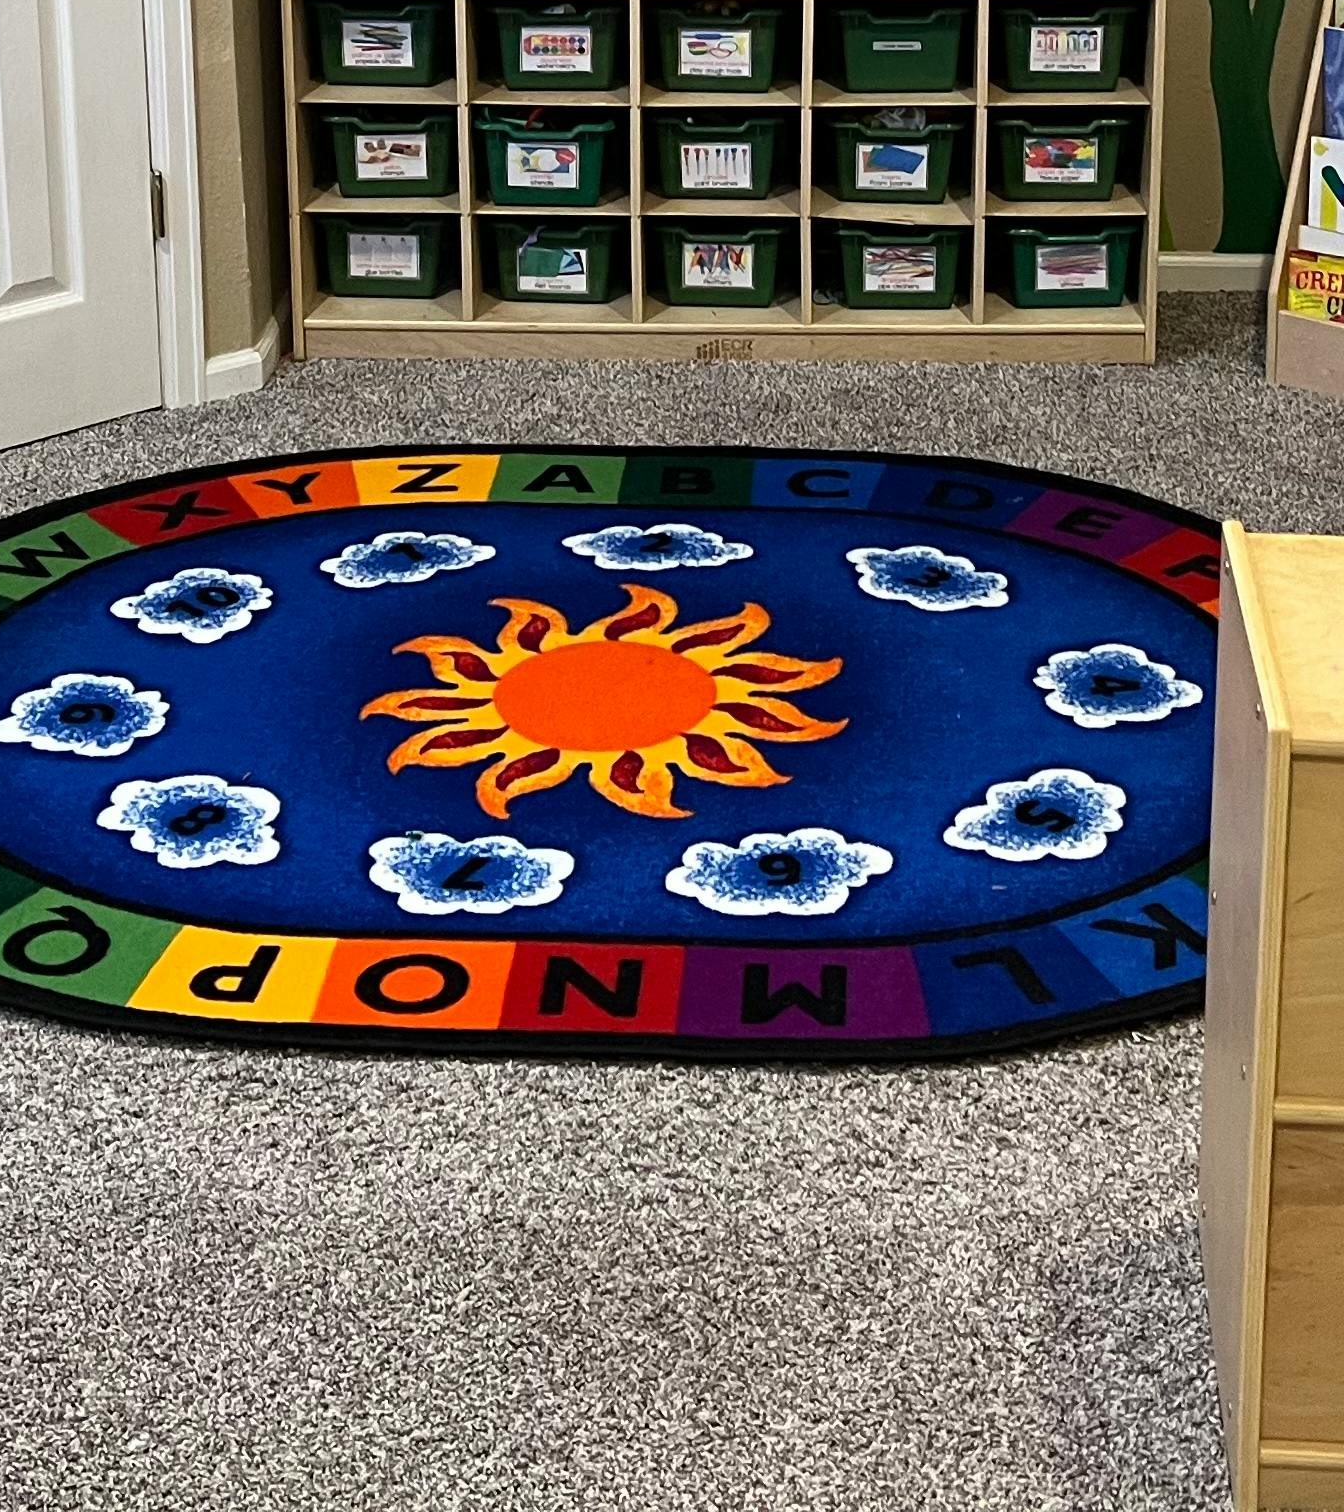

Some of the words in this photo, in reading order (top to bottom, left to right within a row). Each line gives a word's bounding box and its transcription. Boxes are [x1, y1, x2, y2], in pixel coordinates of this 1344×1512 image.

[257, 471, 324, 505] Y
[392, 463, 461, 494] Z
[523, 464, 595, 494] A
[660, 466, 713, 495] B
[787, 469, 851, 498] C
[133, 490, 232, 532] X
[926, 481, 995, 513] D
[1055, 507, 1126, 538] E
[907, 564, 953, 590] 3
[166, 587, 241, 620] 10
[1092, 674, 1141, 696] 4
[61, 702, 114, 726] 9
[169, 805, 224, 836] 8
[1015, 798, 1076, 834] 5
[444, 857, 487, 889] 7
[760, 854, 802, 885] 6
[2, 905, 112, 976] Q
[1088, 903, 1207, 971] K
[189, 946, 281, 1003] P
[355, 954, 471, 1015] O
[540, 959, 644, 1017] N
[954, 948, 1056, 1004] L
[741, 963, 847, 1025] M
